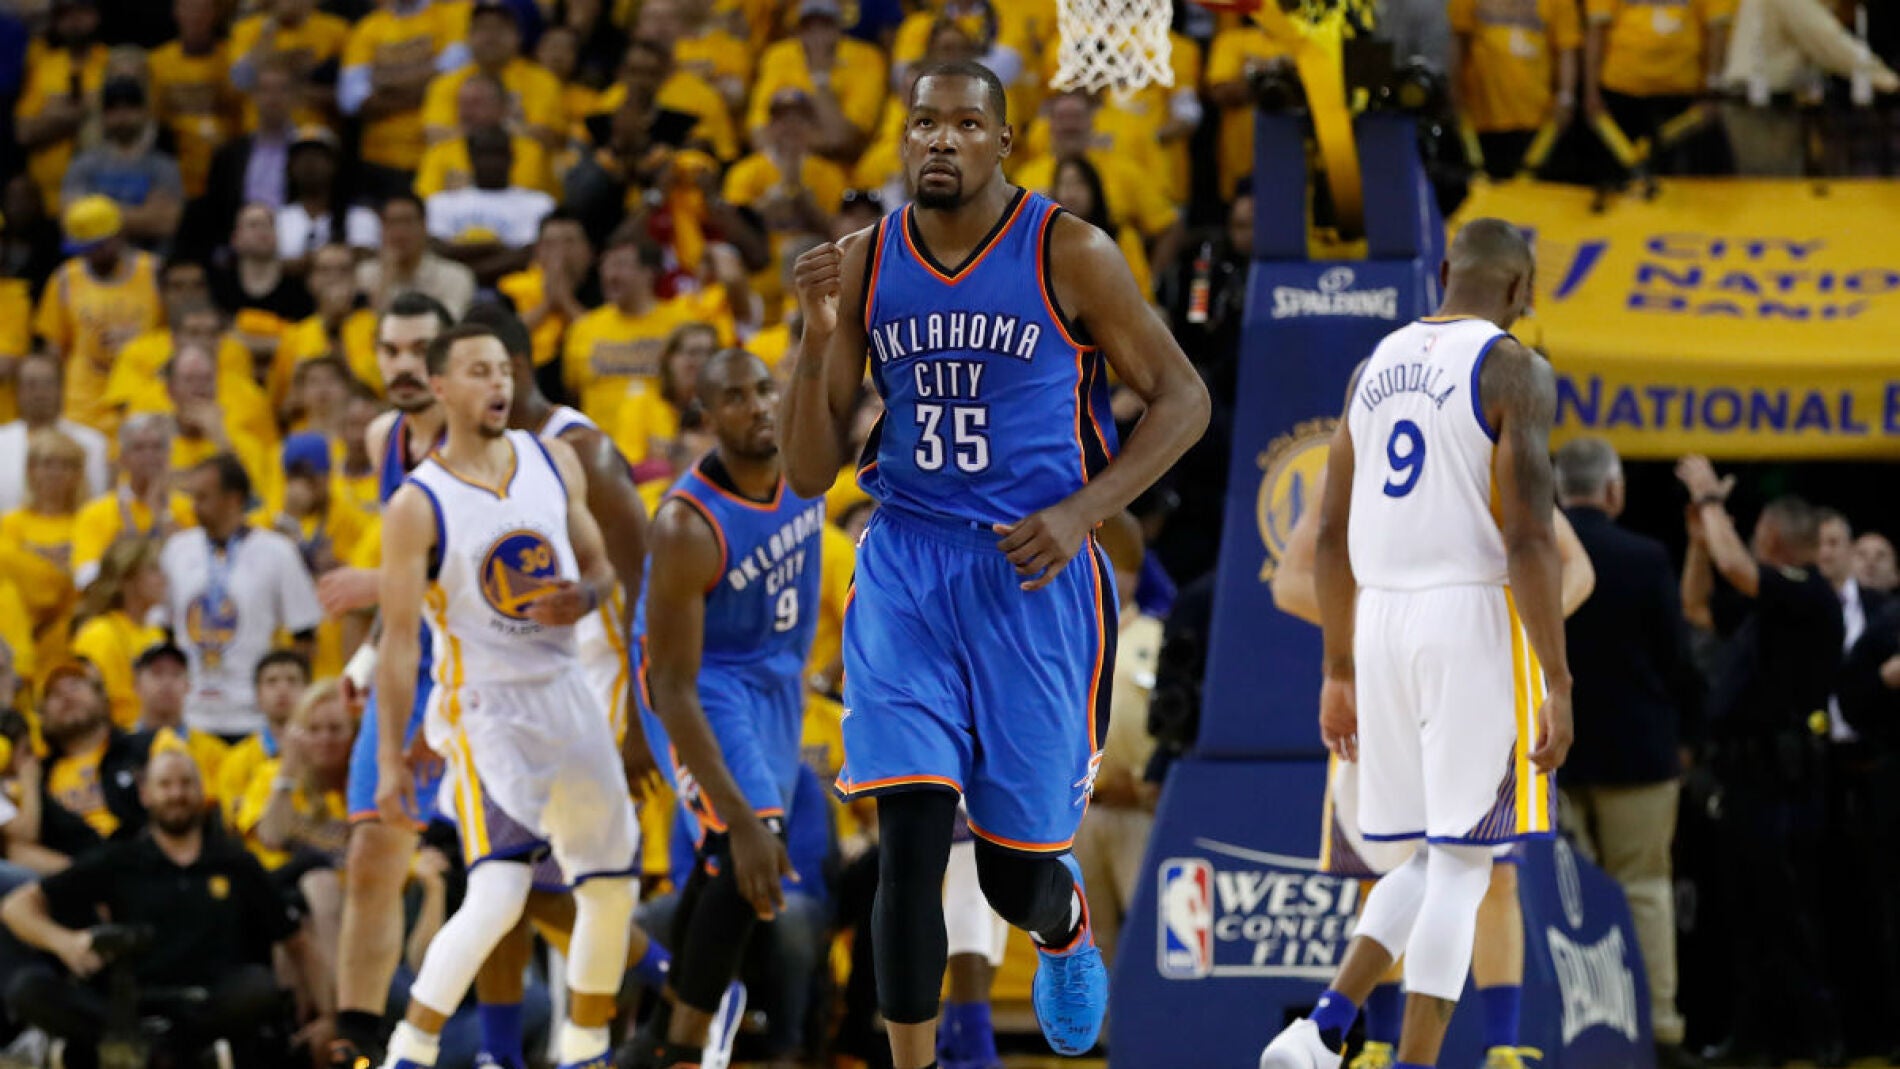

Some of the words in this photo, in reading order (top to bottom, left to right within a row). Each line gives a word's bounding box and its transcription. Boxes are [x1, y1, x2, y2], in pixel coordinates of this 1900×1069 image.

[1645, 234, 1829, 260] CITY
[1271, 285, 1397, 320] SPALDING
[872, 311, 1042, 363] OKLAHOMA
[913, 360, 984, 398] CITY
[1359, 362, 1456, 413] IGUODALA
[1553, 374, 1870, 436] NATIONAL
[913, 402, 991, 473] 35
[1382, 418, 1427, 499] 9
[519, 544, 551, 573] 30
[765, 547, 805, 596] CITY
[773, 586, 799, 633] 9
